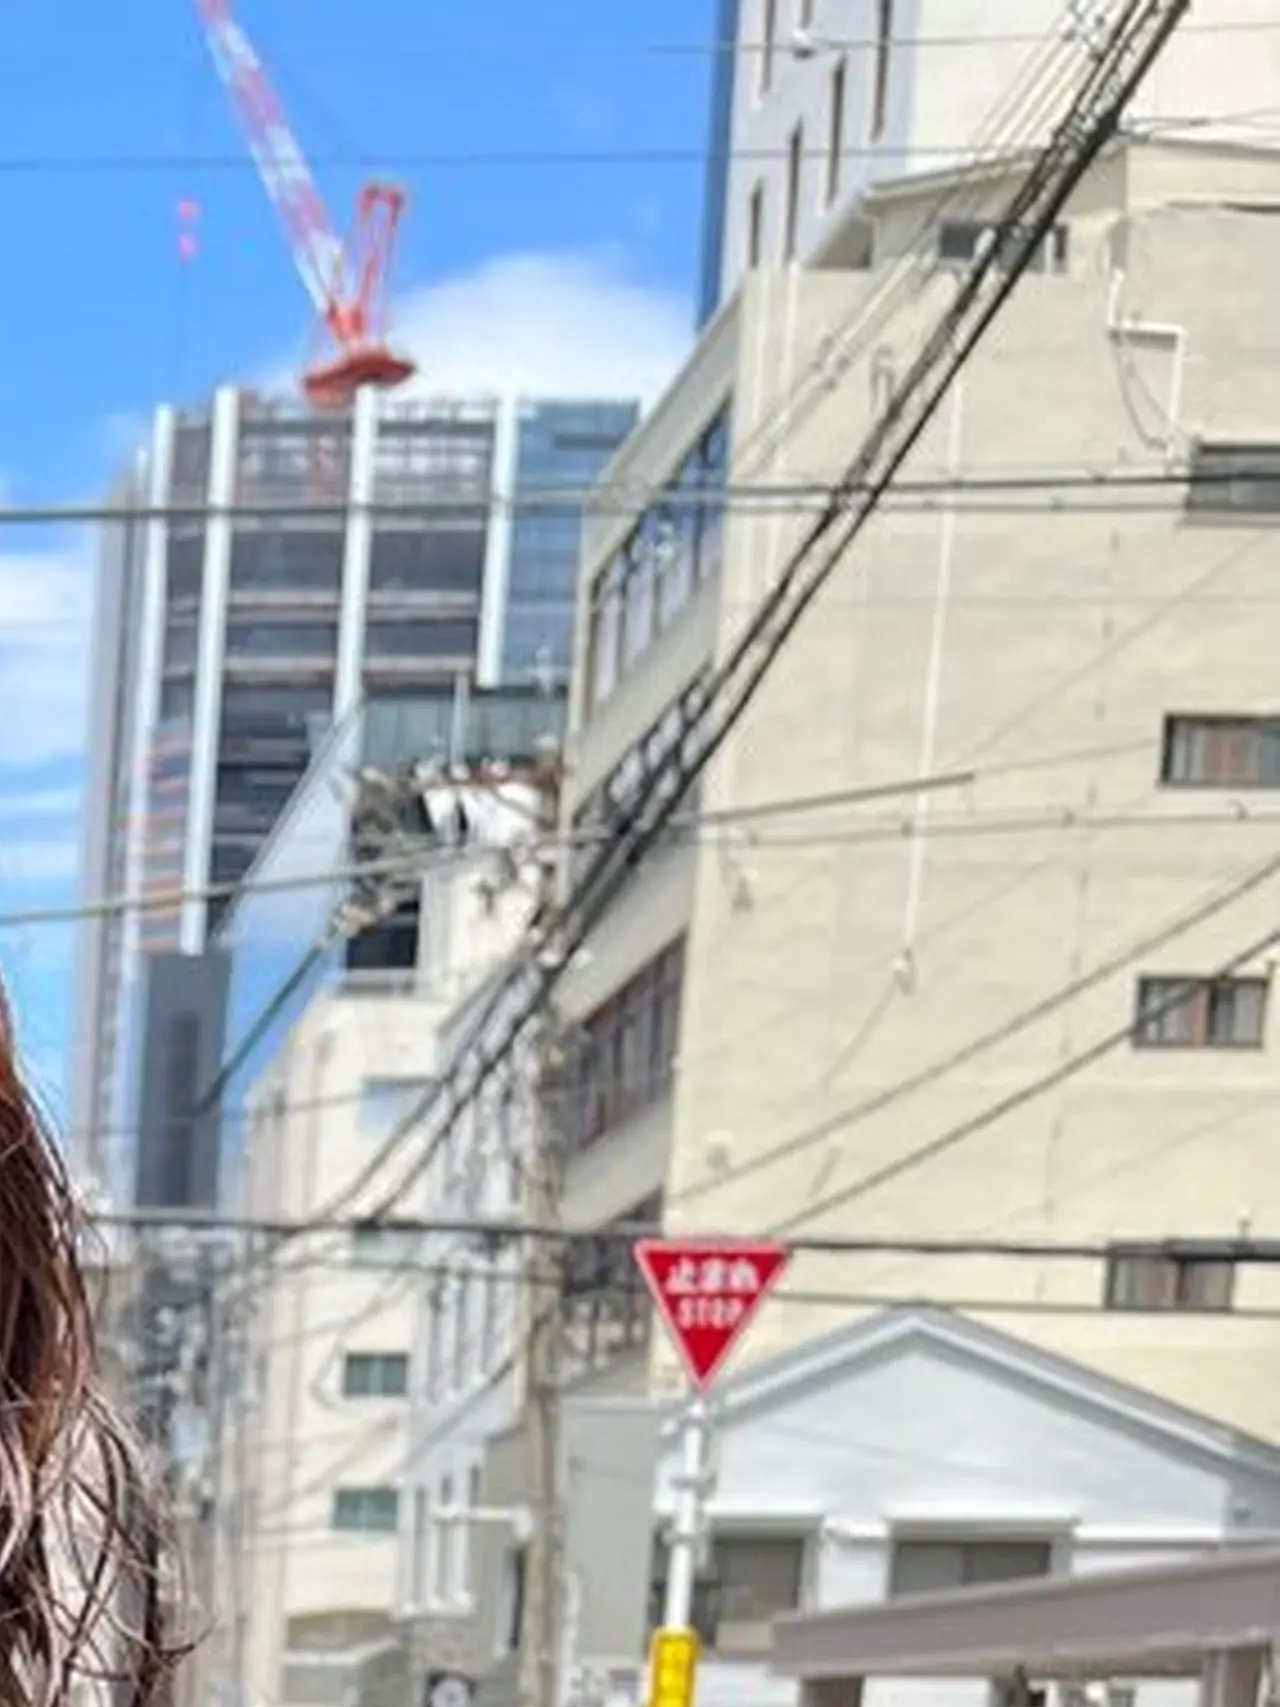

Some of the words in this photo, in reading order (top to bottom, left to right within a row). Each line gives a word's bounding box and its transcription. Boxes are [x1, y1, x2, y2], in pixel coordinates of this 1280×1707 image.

[665, 1256, 760, 1294] 止まれ
[678, 1297, 744, 1330] STOP
